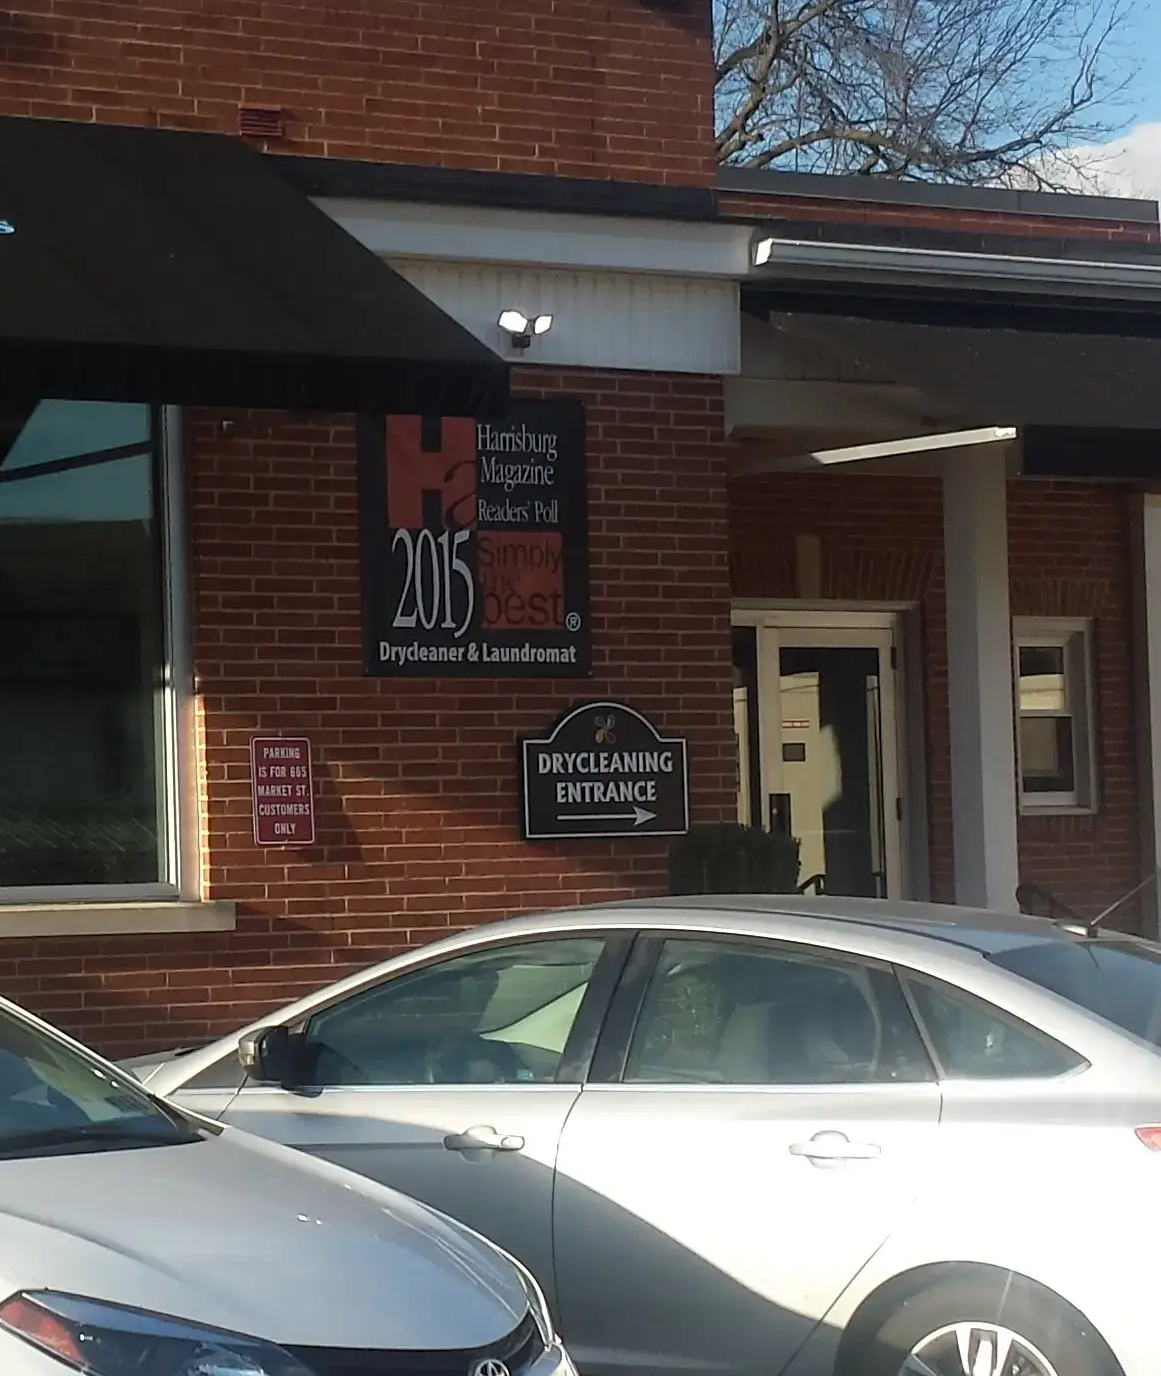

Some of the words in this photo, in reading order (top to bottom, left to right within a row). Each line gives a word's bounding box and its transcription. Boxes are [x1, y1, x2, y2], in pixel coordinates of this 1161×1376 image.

[477, 424, 558, 461] Harrisburg
[480, 456, 555, 492] Magazine
[534, 499, 559, 524] Poll
[478, 536, 562, 574] Simply
[392, 528, 475, 639] 2015
[379, 641, 465, 667] Drycleaner
[467, 642, 479, 662] &
[482, 642, 577, 663] Laundromat
[263, 747, 300, 759] PARKING
[538, 751, 673, 774] DRYCLEANING
[258, 766, 268, 778] IS
[270, 766, 286, 778] FOR
[257, 785, 292, 797] MARKET
[295, 785, 310, 797] ST.
[556, 780, 657, 803] ENTRANCE
[259, 804, 310, 816] CUSTOMERS
[274, 823, 296, 835] ONLY
